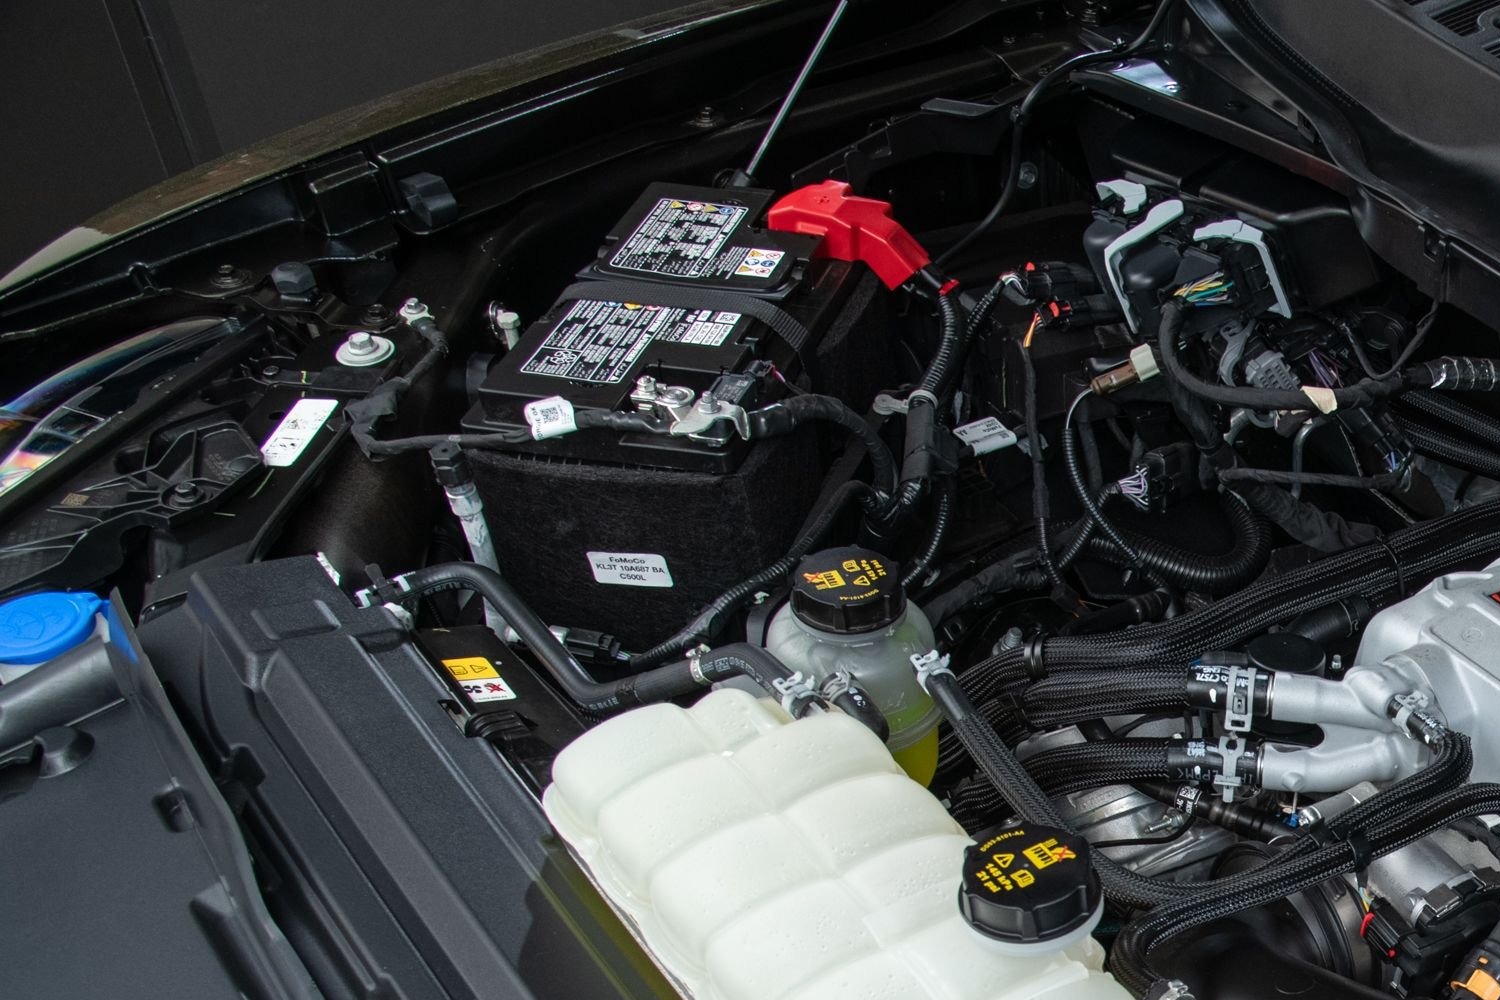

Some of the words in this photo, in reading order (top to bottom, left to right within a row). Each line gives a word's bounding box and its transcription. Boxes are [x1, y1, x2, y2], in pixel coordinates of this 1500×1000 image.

[608, 556, 646, 564] FoMoCo
[596, 563, 617, 571] KL3T
[620, 565, 650, 573] 10A687
[652, 566, 665, 574] BA
[976, 871, 990, 881] 21
[984, 881, 1001, 892] psi
[986, 863, 1002, 877] 145
[997, 875, 1013, 890] kPa
